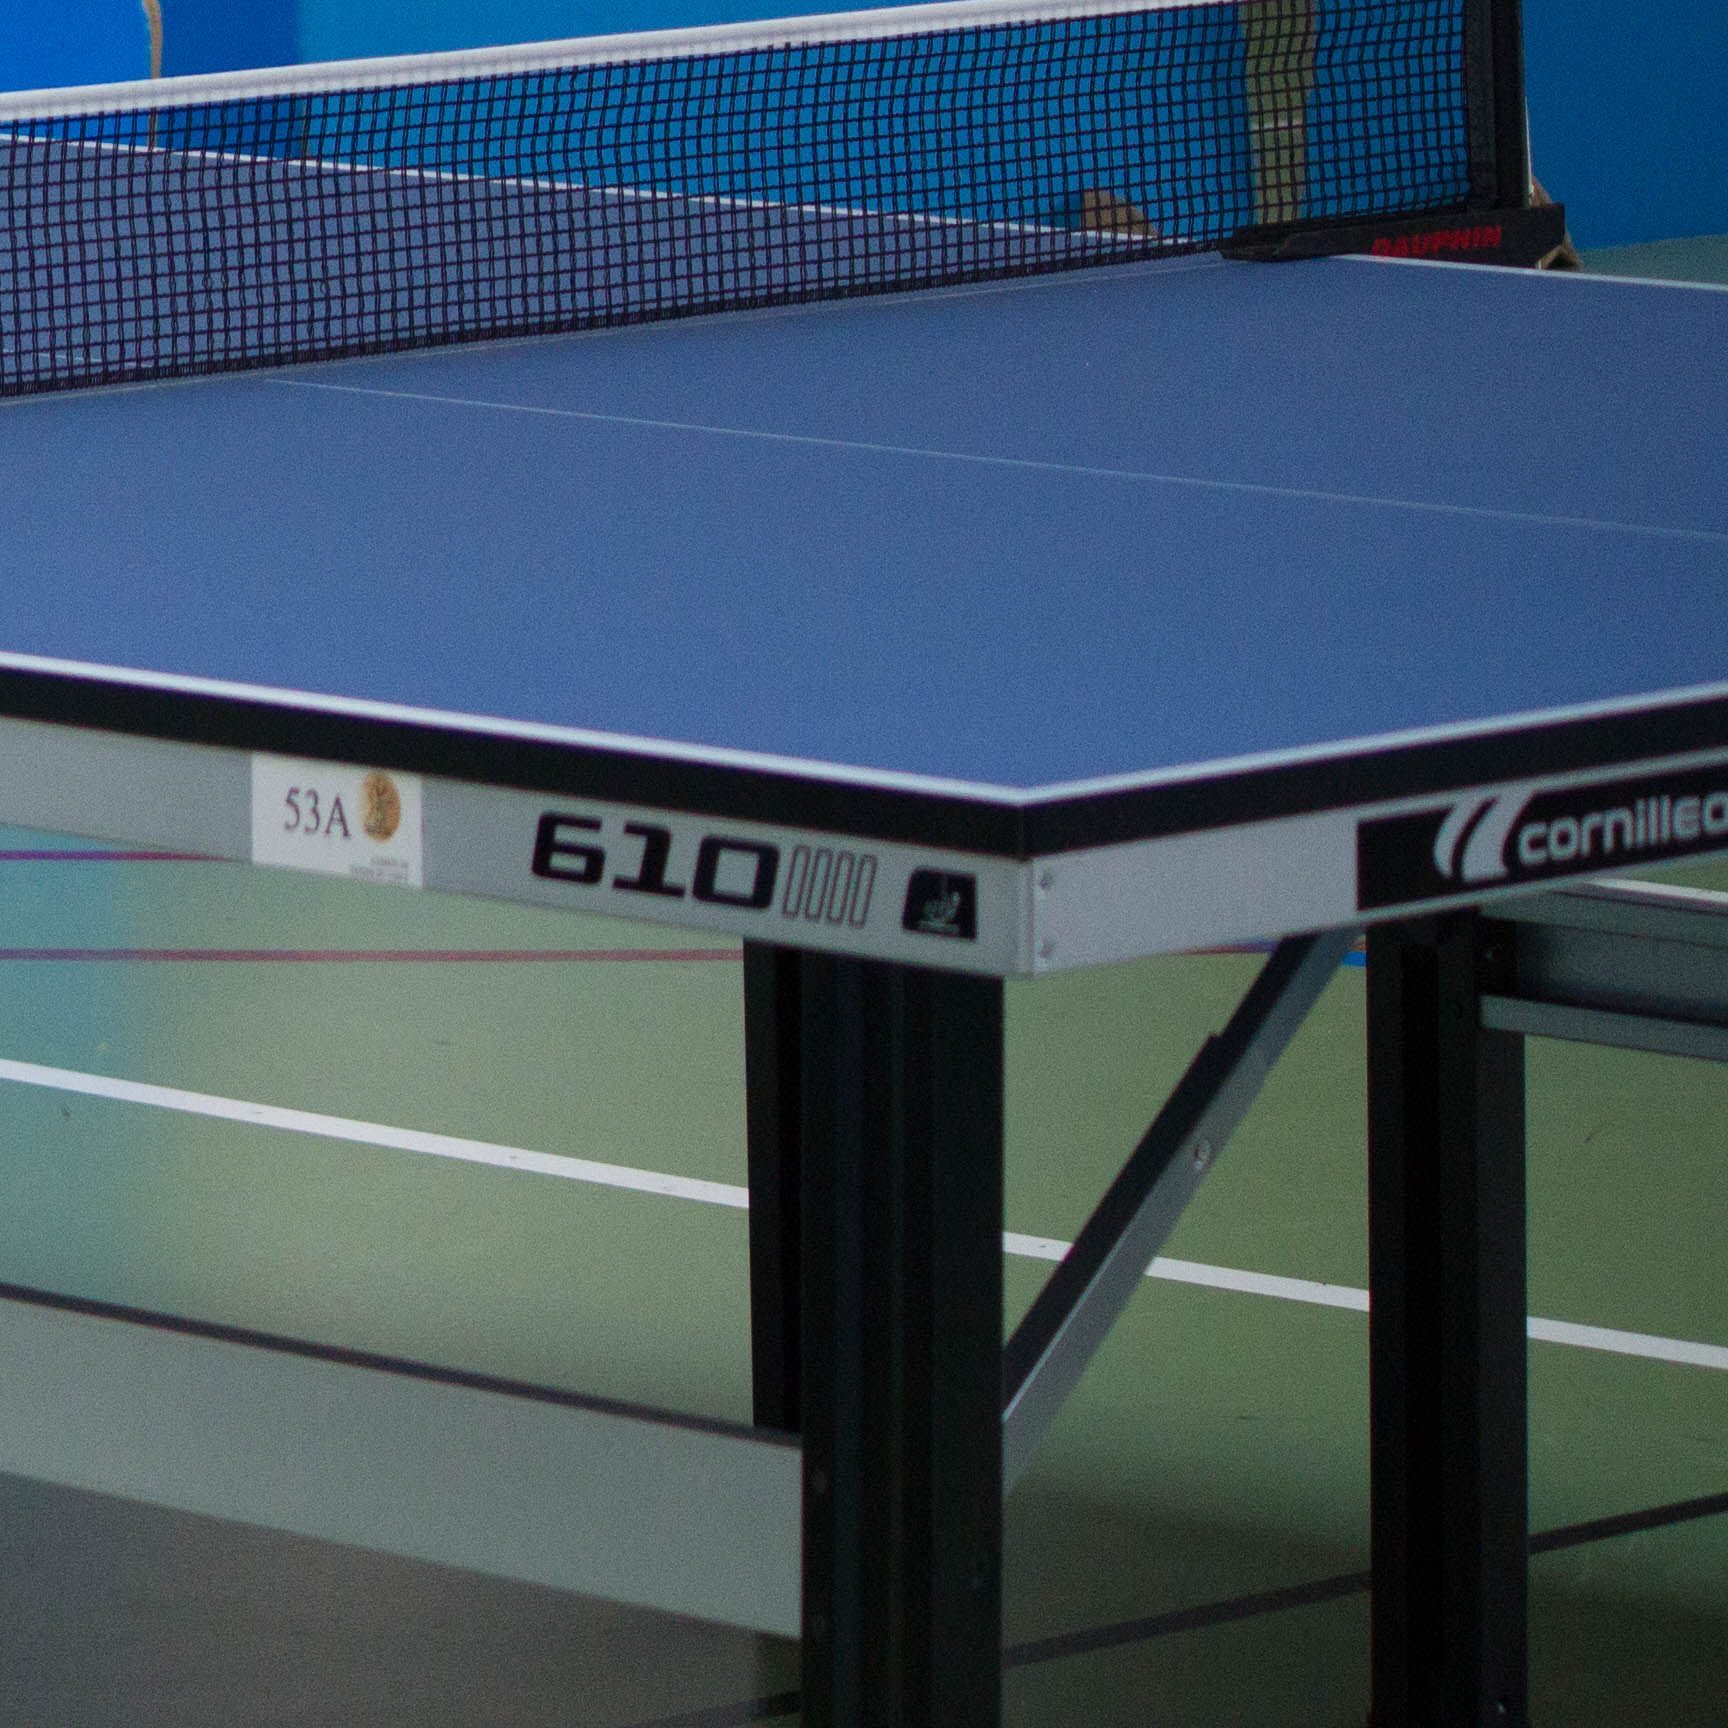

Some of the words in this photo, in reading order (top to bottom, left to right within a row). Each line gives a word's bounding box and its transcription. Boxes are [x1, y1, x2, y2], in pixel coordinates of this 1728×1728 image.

[1371, 225, 1503, 258] DAUPHIN
[284, 786, 353, 839] 53A
[530, 810, 781, 911] 610
